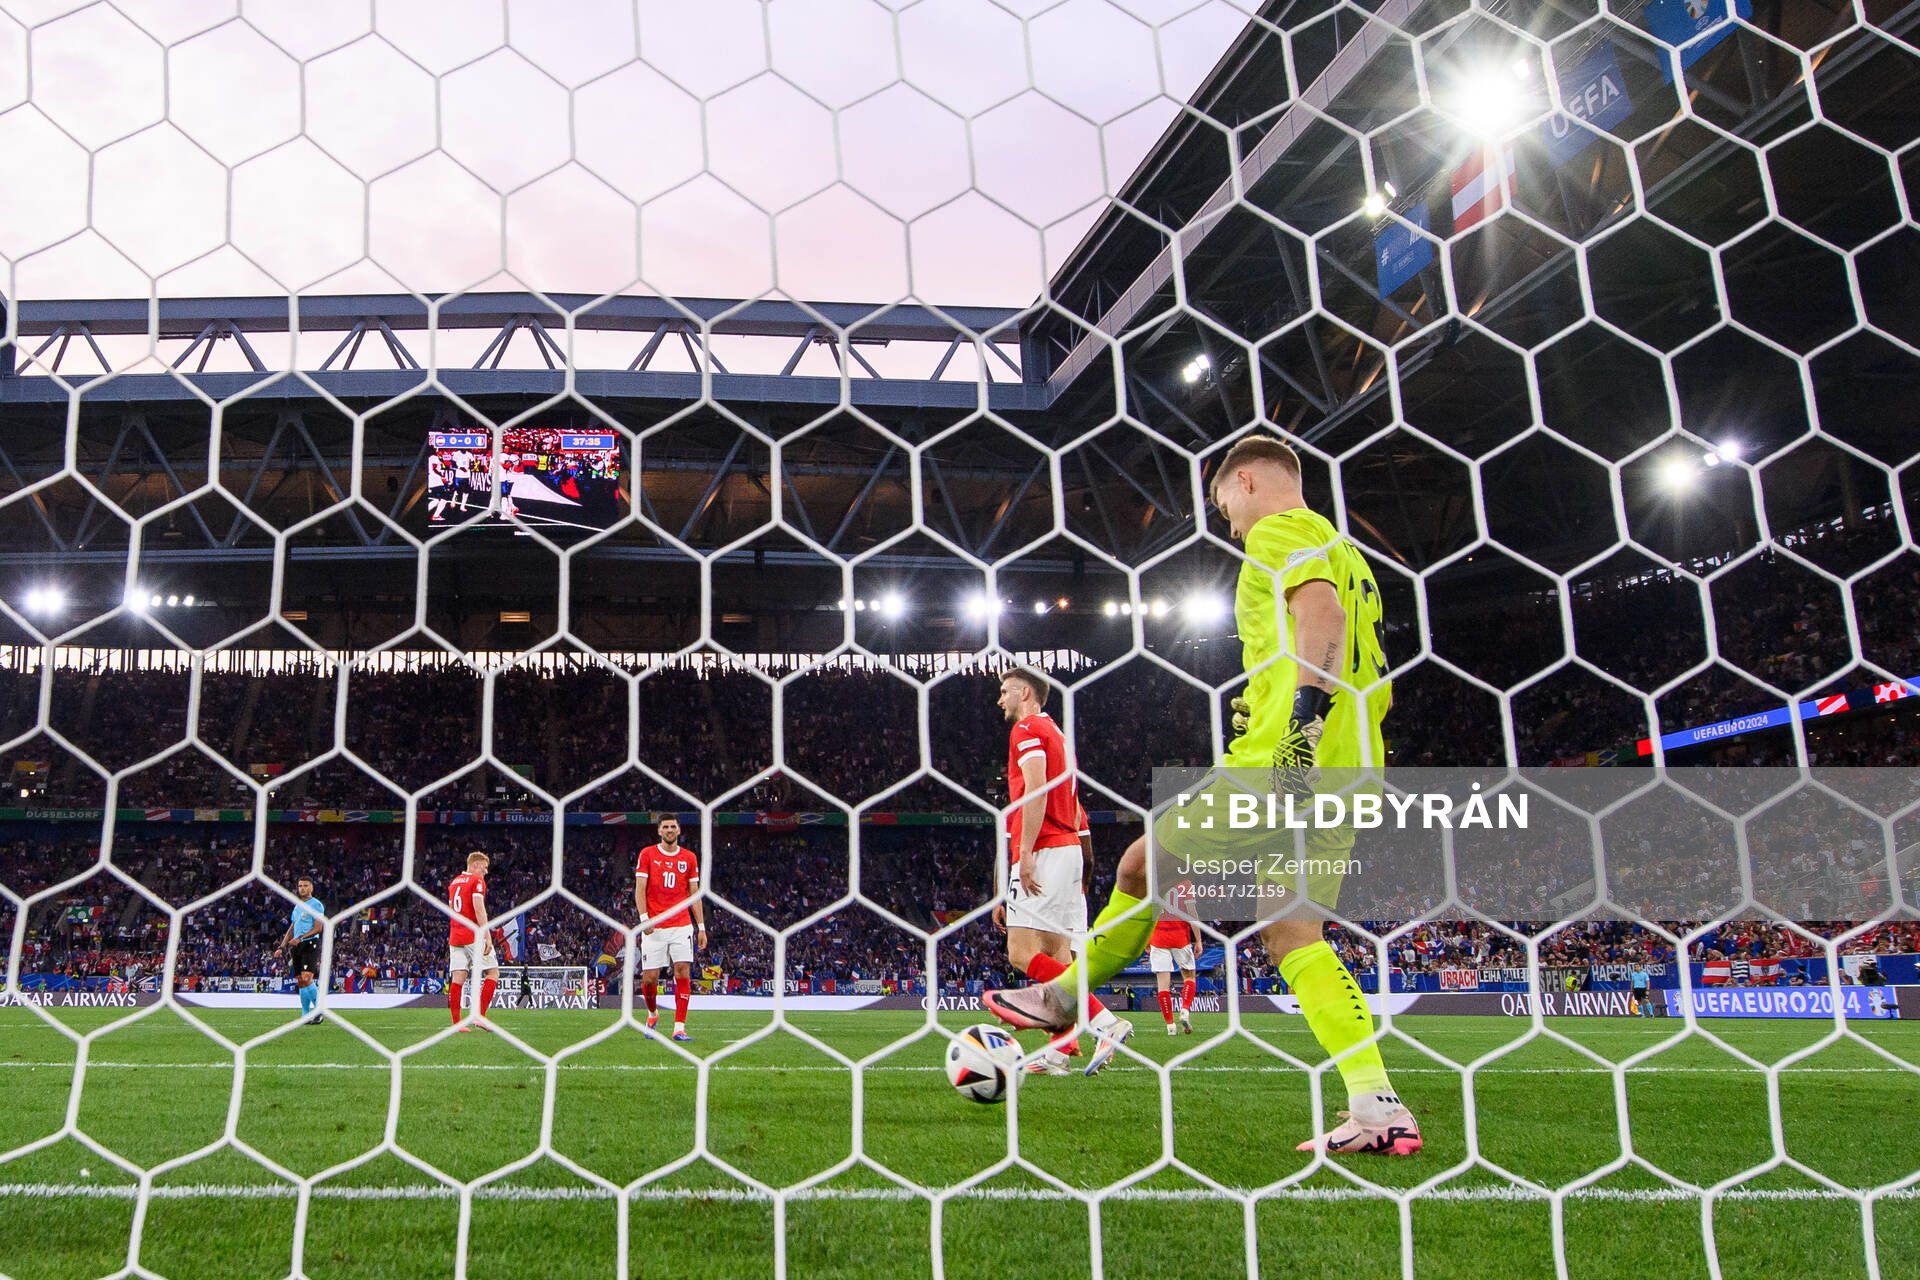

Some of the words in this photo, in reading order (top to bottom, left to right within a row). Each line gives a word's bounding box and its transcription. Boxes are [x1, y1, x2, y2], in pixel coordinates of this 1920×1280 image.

[1550, 75, 1620, 139] UEFA
[662, 871, 676, 889] 10
[453, 886, 462, 912] 6
[1440, 970, 1477, 987] URBACH
[61, 992, 136, 1007] AIRWAYS
[1564, 992, 1631, 1015] AIRWAY
